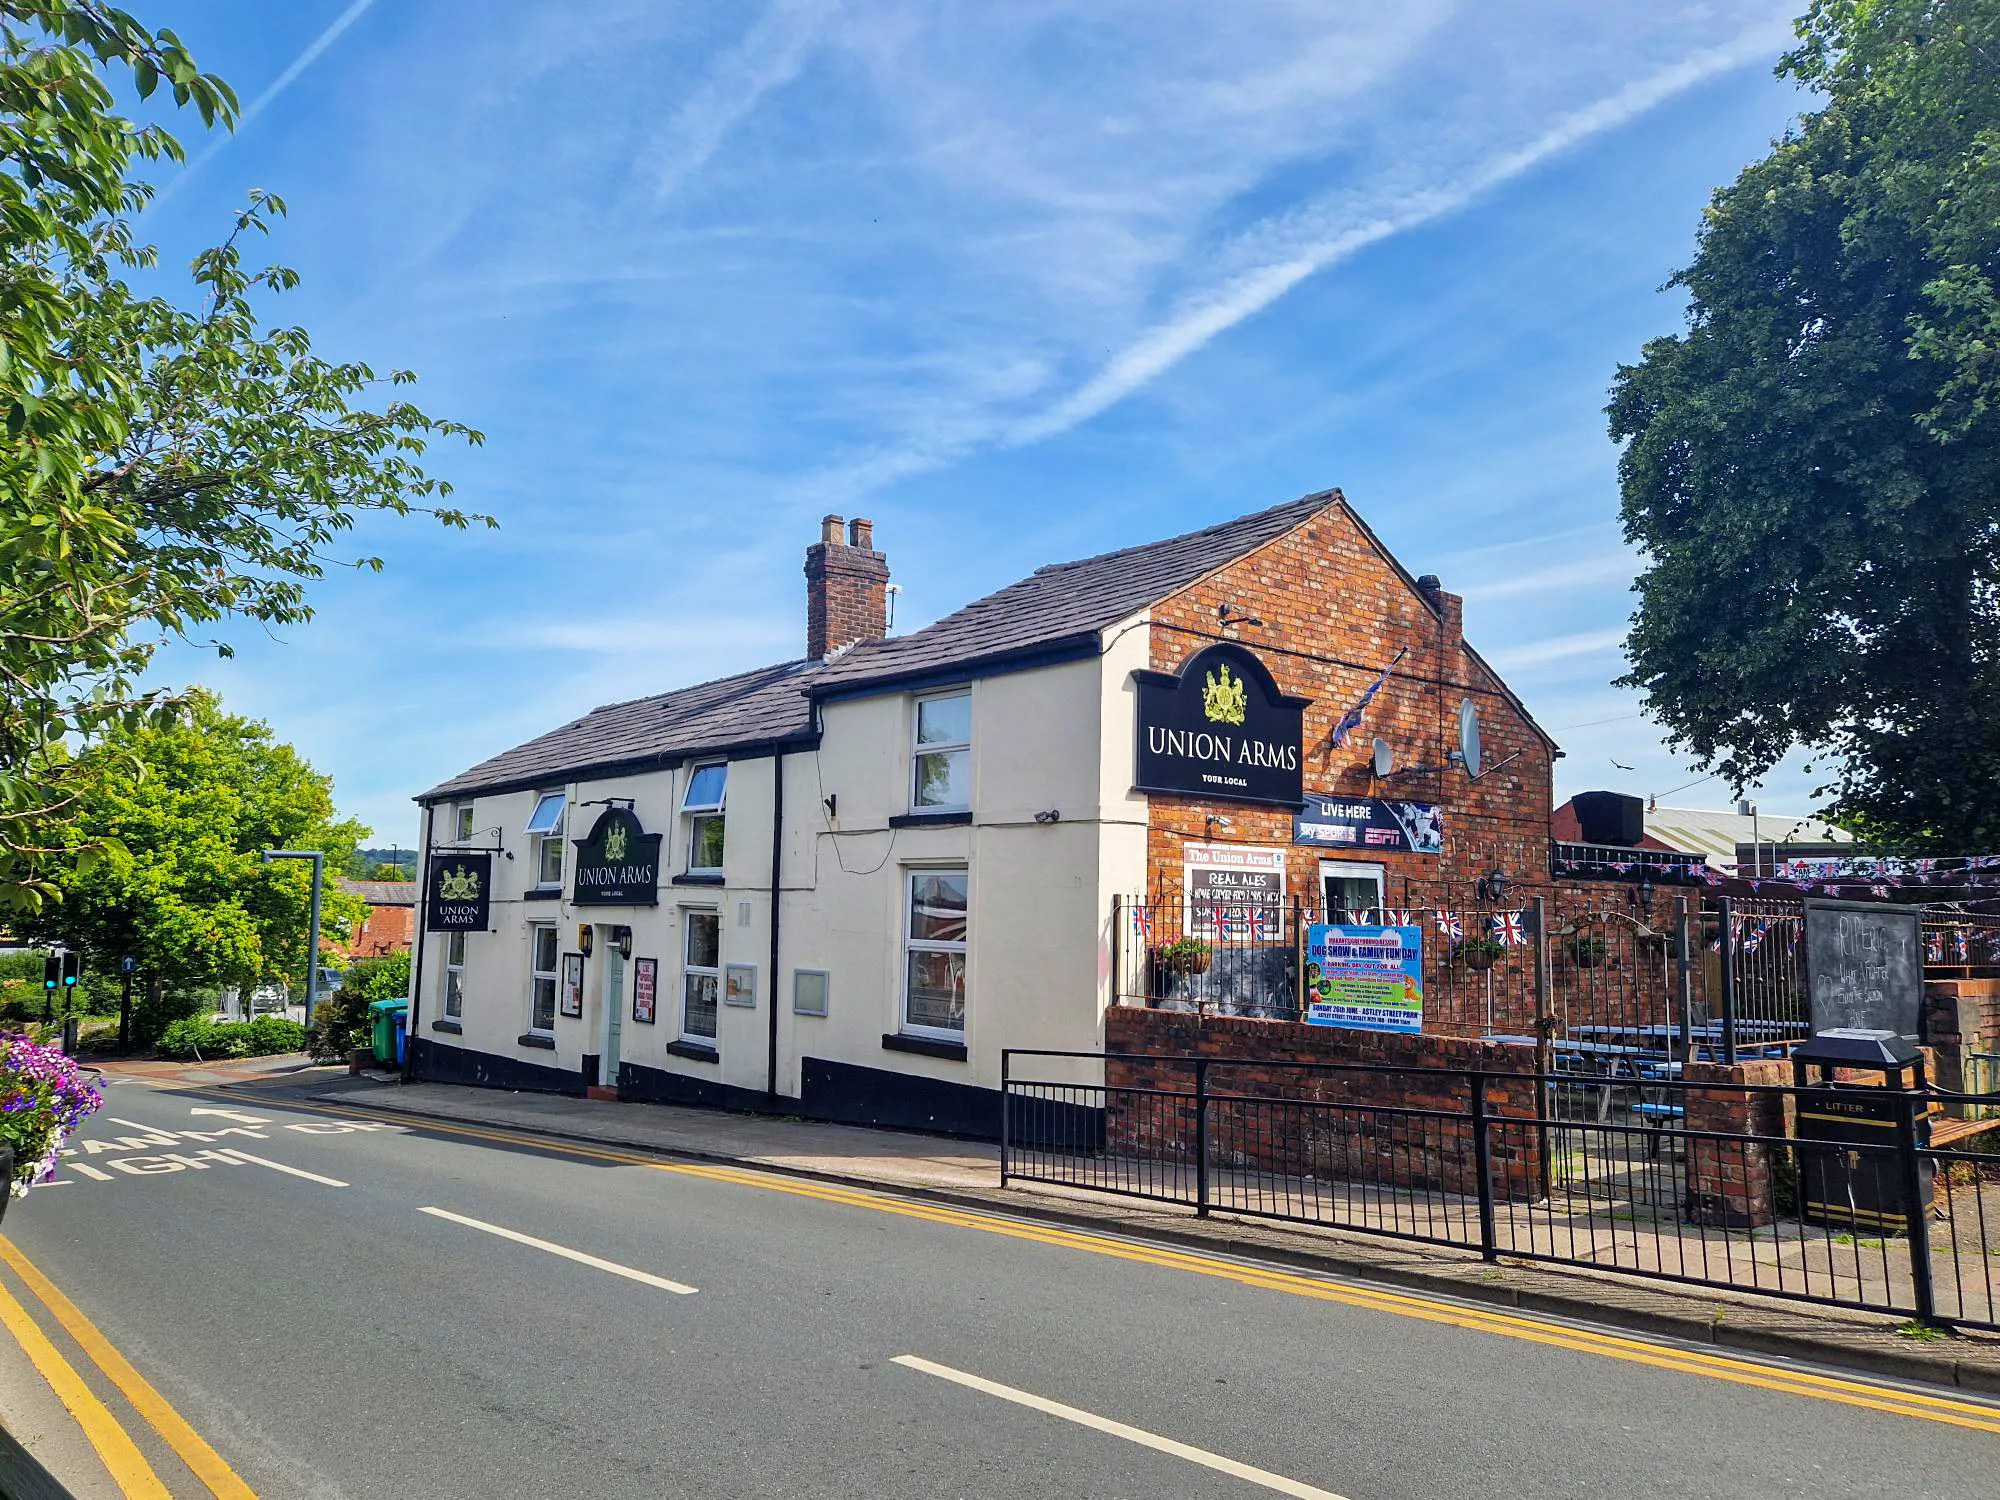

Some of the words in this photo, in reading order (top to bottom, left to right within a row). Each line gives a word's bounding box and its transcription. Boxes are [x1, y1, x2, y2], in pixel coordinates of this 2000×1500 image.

[1149, 726, 1231, 763] UNION
[1238, 739, 1297, 771] ARMS
[1202, 774, 1223, 784] YOUR
[1224, 776, 1248, 787] LOCAL
[1321, 802, 1344, 817] LIVE
[1346, 804, 1372, 820] HERE
[1189, 849, 1210, 862] The
[1212, 851, 1243, 864] Union
[1246, 853, 1273, 866] Arms
[579, 866, 617, 886] UNION
[620, 864, 652, 884] ARMS
[1209, 872, 1238, 885] REAL
[1242, 873, 1267, 887] ALES
[440, 906, 479, 915] UNION
[443, 915, 474, 924] ARMS
[1312, 945, 1327, 957] DOG
[1327, 945, 1351, 958] SHOW
[1351, 947, 1358, 958] &
[1359, 946, 1386, 959] FAMILY
[1385, 947, 1401, 959] FUN
[1402, 948, 1418, 960] DAY
[1313, 1004, 1332, 1012] SUNDAY
[1362, 1008, 1381, 1016] ASTLEY
[1382, 1009, 1402, 1017] STREET
[1825, 1102, 1863, 1112] LITTER
